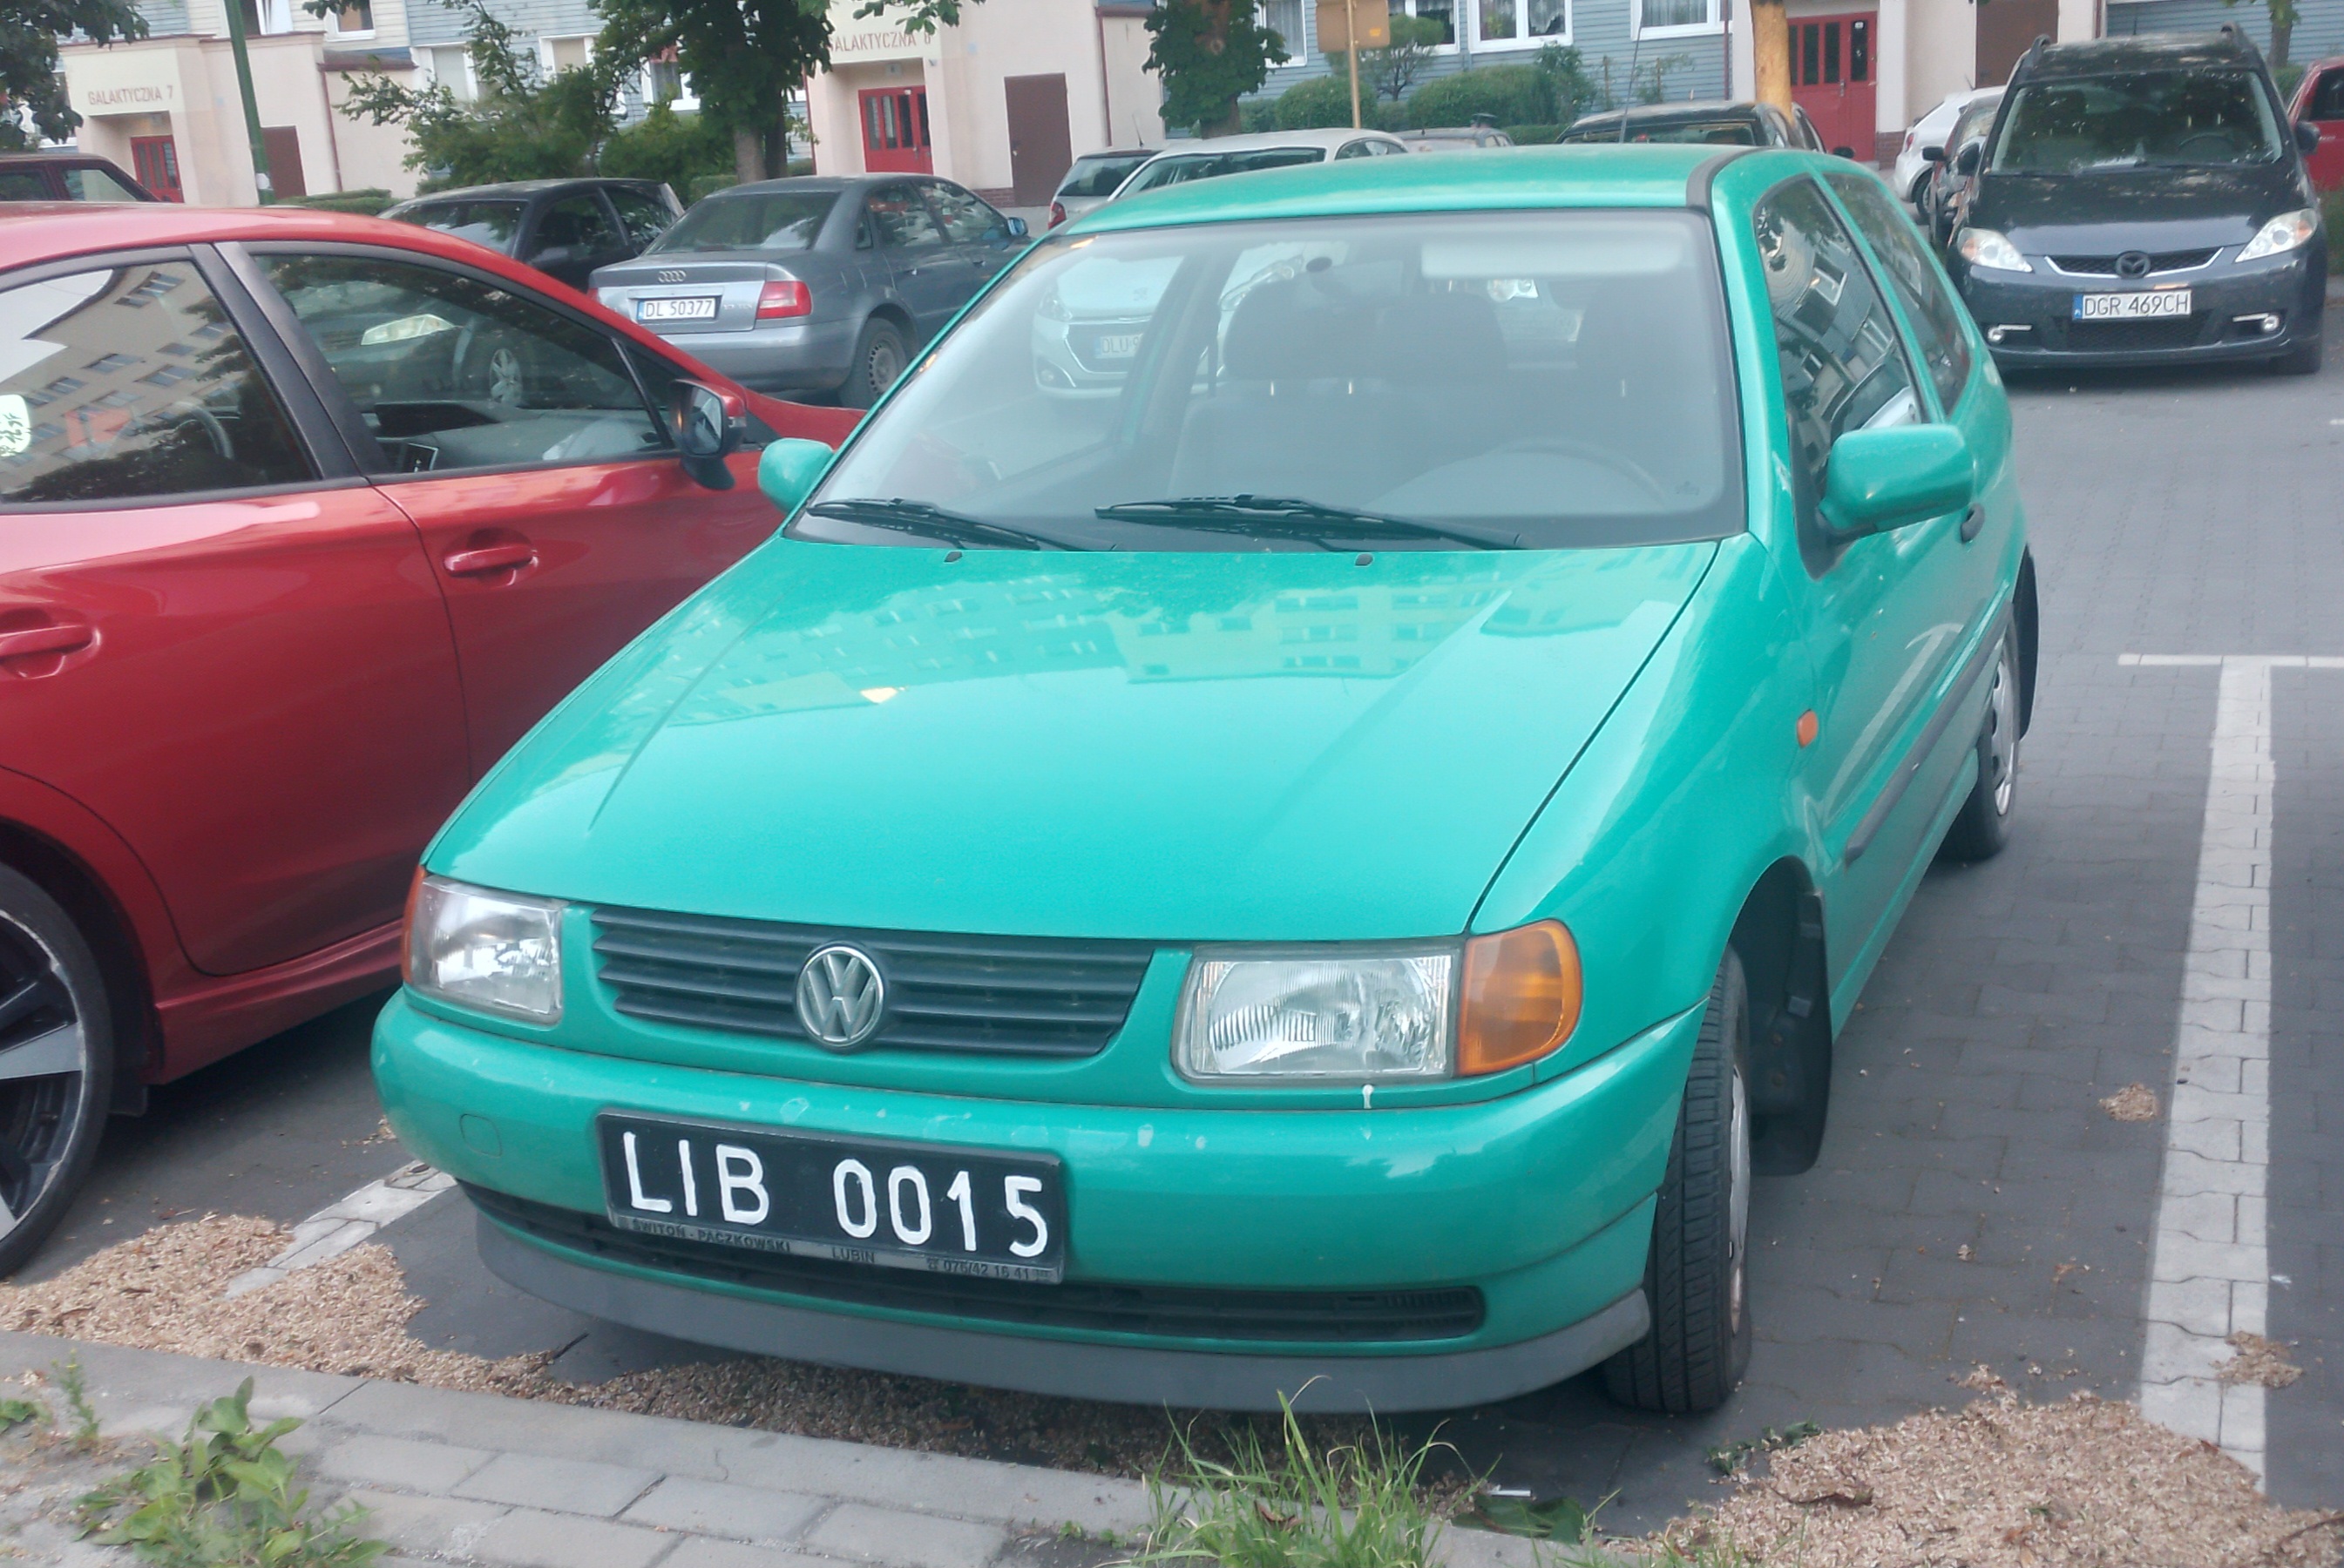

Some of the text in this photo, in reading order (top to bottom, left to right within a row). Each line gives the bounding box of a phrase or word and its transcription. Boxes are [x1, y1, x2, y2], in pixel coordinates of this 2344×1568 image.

[88, 84, 173, 105] GALAKTYCZNA 7
[645, 301, 664, 318] DL
[669, 300, 713, 317] 50377
[2083, 293, 2189, 316] DGR 469CH
[622, 1131, 1048, 1258] LIB 0015
[831, 1246, 876, 1263] LUBIN
